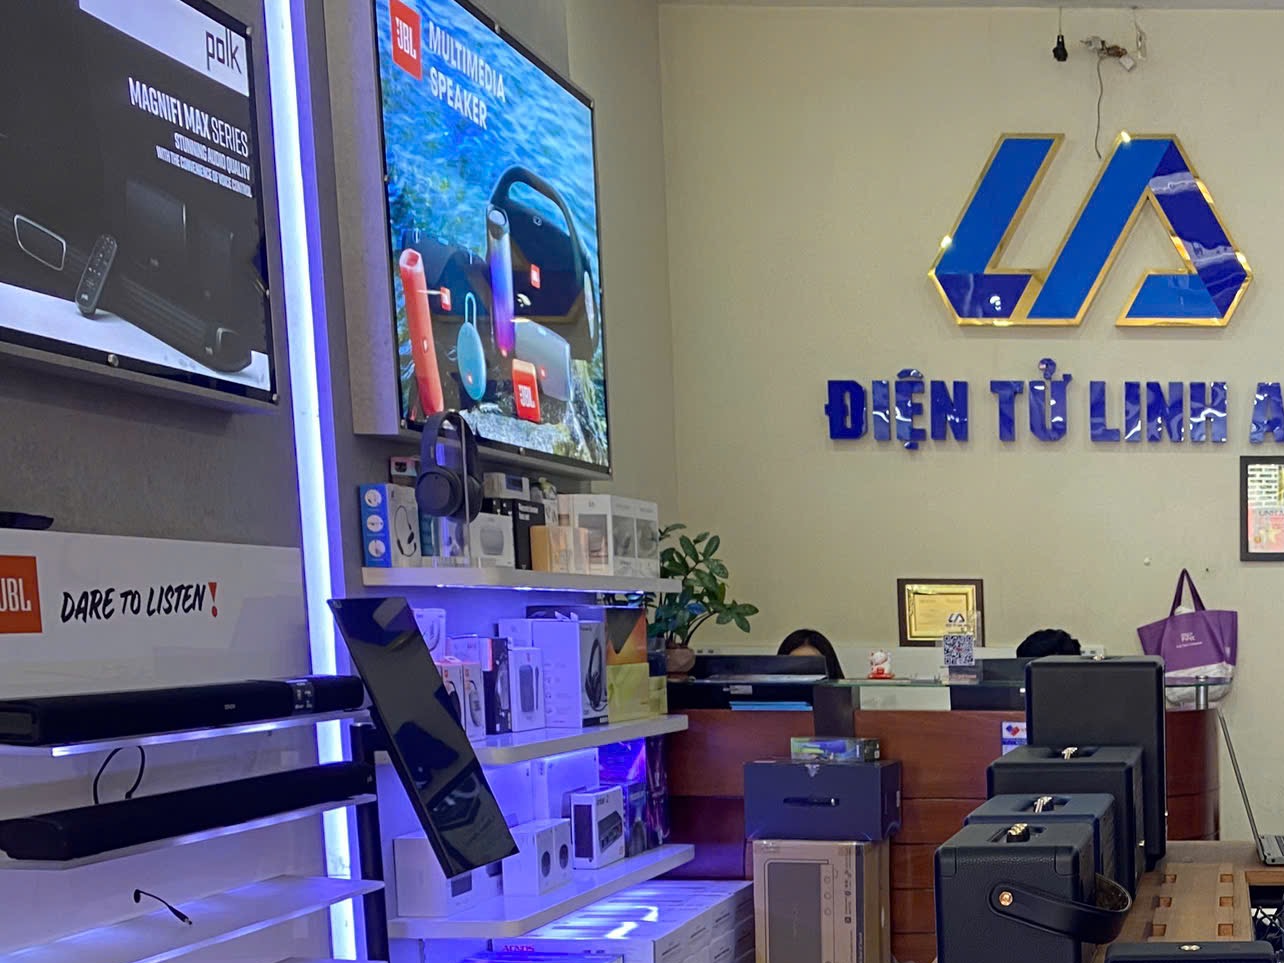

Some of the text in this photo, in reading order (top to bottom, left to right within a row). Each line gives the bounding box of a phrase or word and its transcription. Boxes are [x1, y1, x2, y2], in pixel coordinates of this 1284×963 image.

[205, 28, 242, 75] polk
[395, 16, 417, 60] JBL
[429, 20, 506, 103] MULTIMEDIA
[128, 77, 249, 158] MAGNIFI MAX SERIES
[430, 66, 487, 130] SPEAKER
[174, 132, 250, 181] STUNNING AUDIO QUALITY
[518, 384, 536, 408] JBL
[825, 368, 968, 451] ĐIỆN
[990, 358, 1072, 442] TỬ
[1090, 381, 1227, 443] LINH
[61, 581, 218, 623] DARE TO LISTEN!
